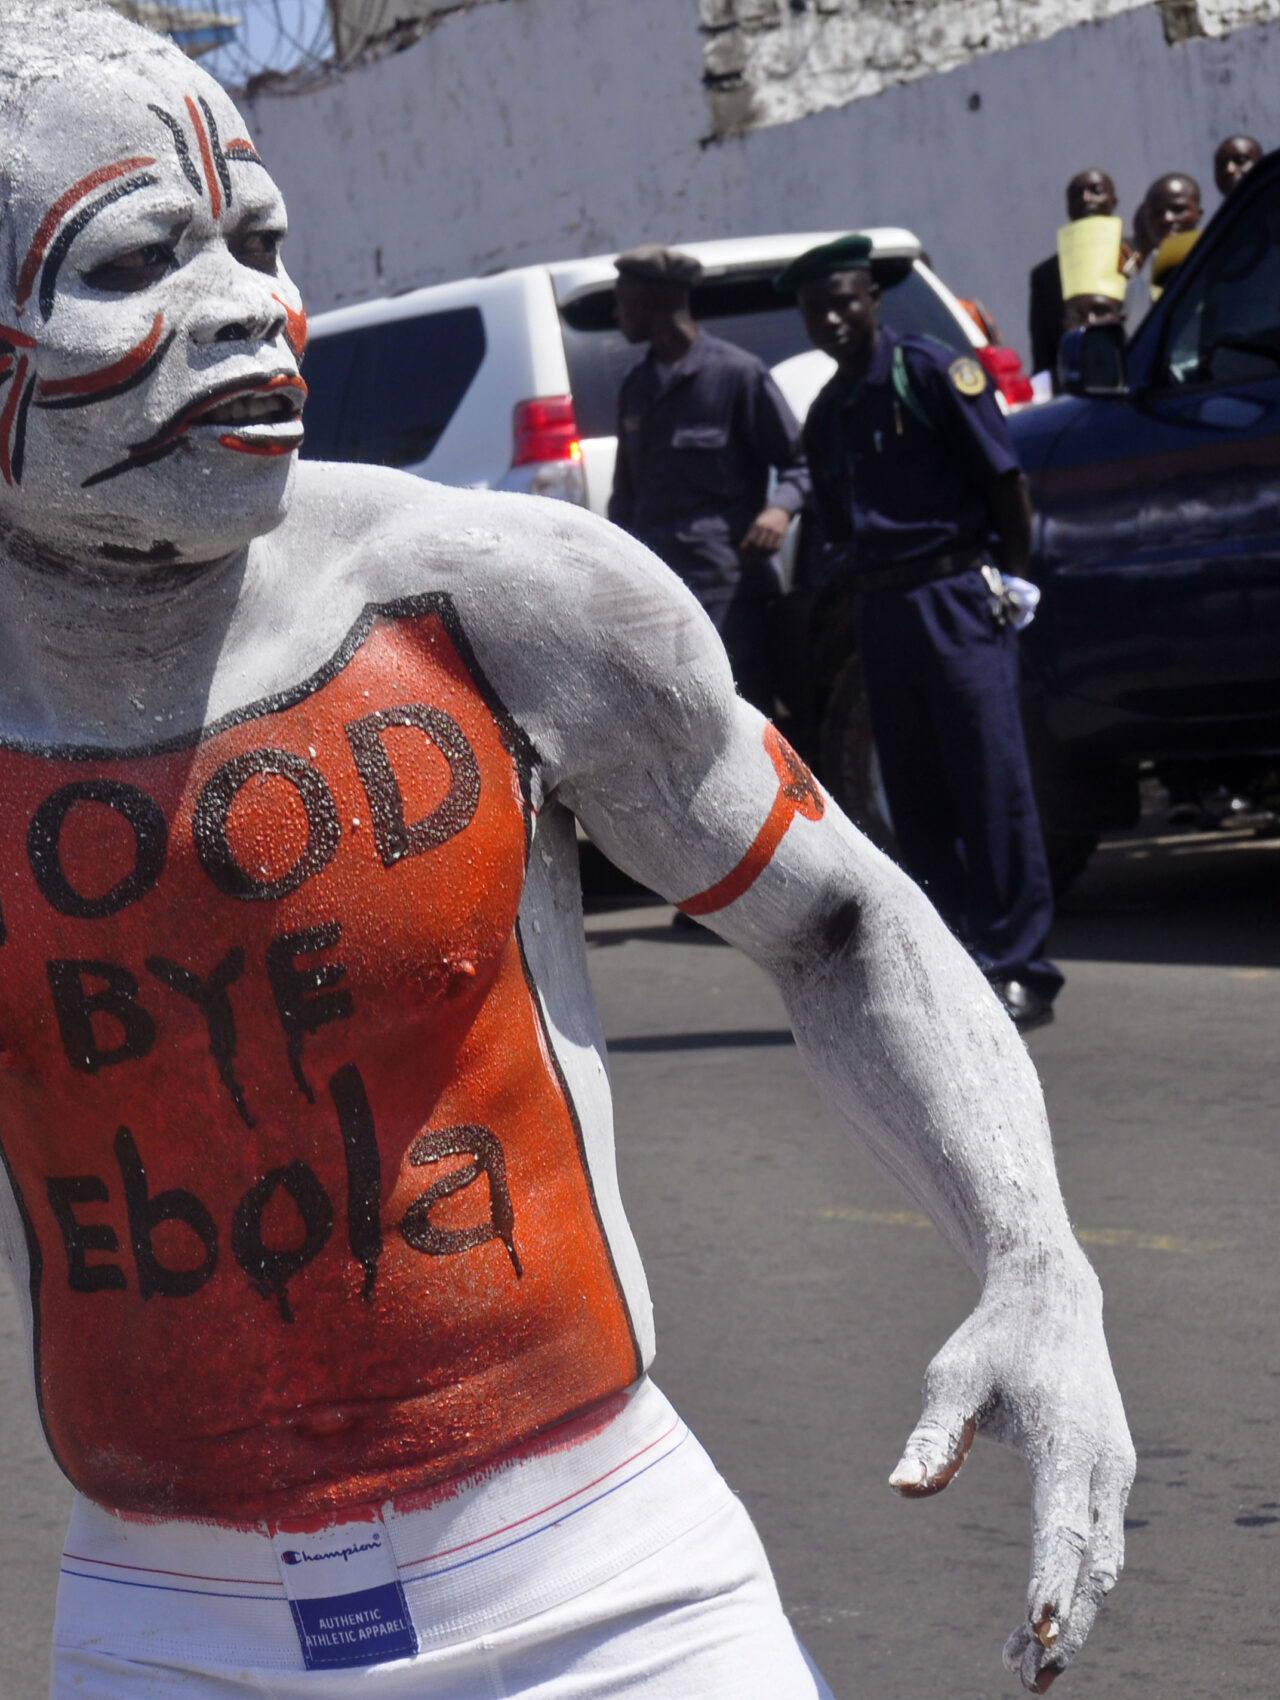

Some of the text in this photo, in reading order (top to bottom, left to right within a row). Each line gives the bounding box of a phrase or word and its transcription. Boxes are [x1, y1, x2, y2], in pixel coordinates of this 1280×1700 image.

[45, 922, 353, 1128] BYE
[45, 1063, 523, 1323] Ebola
[305, 1618, 407, 1647] ATHLETIC APPAREL
[319, 1609, 381, 1630] AUTHENTIC
